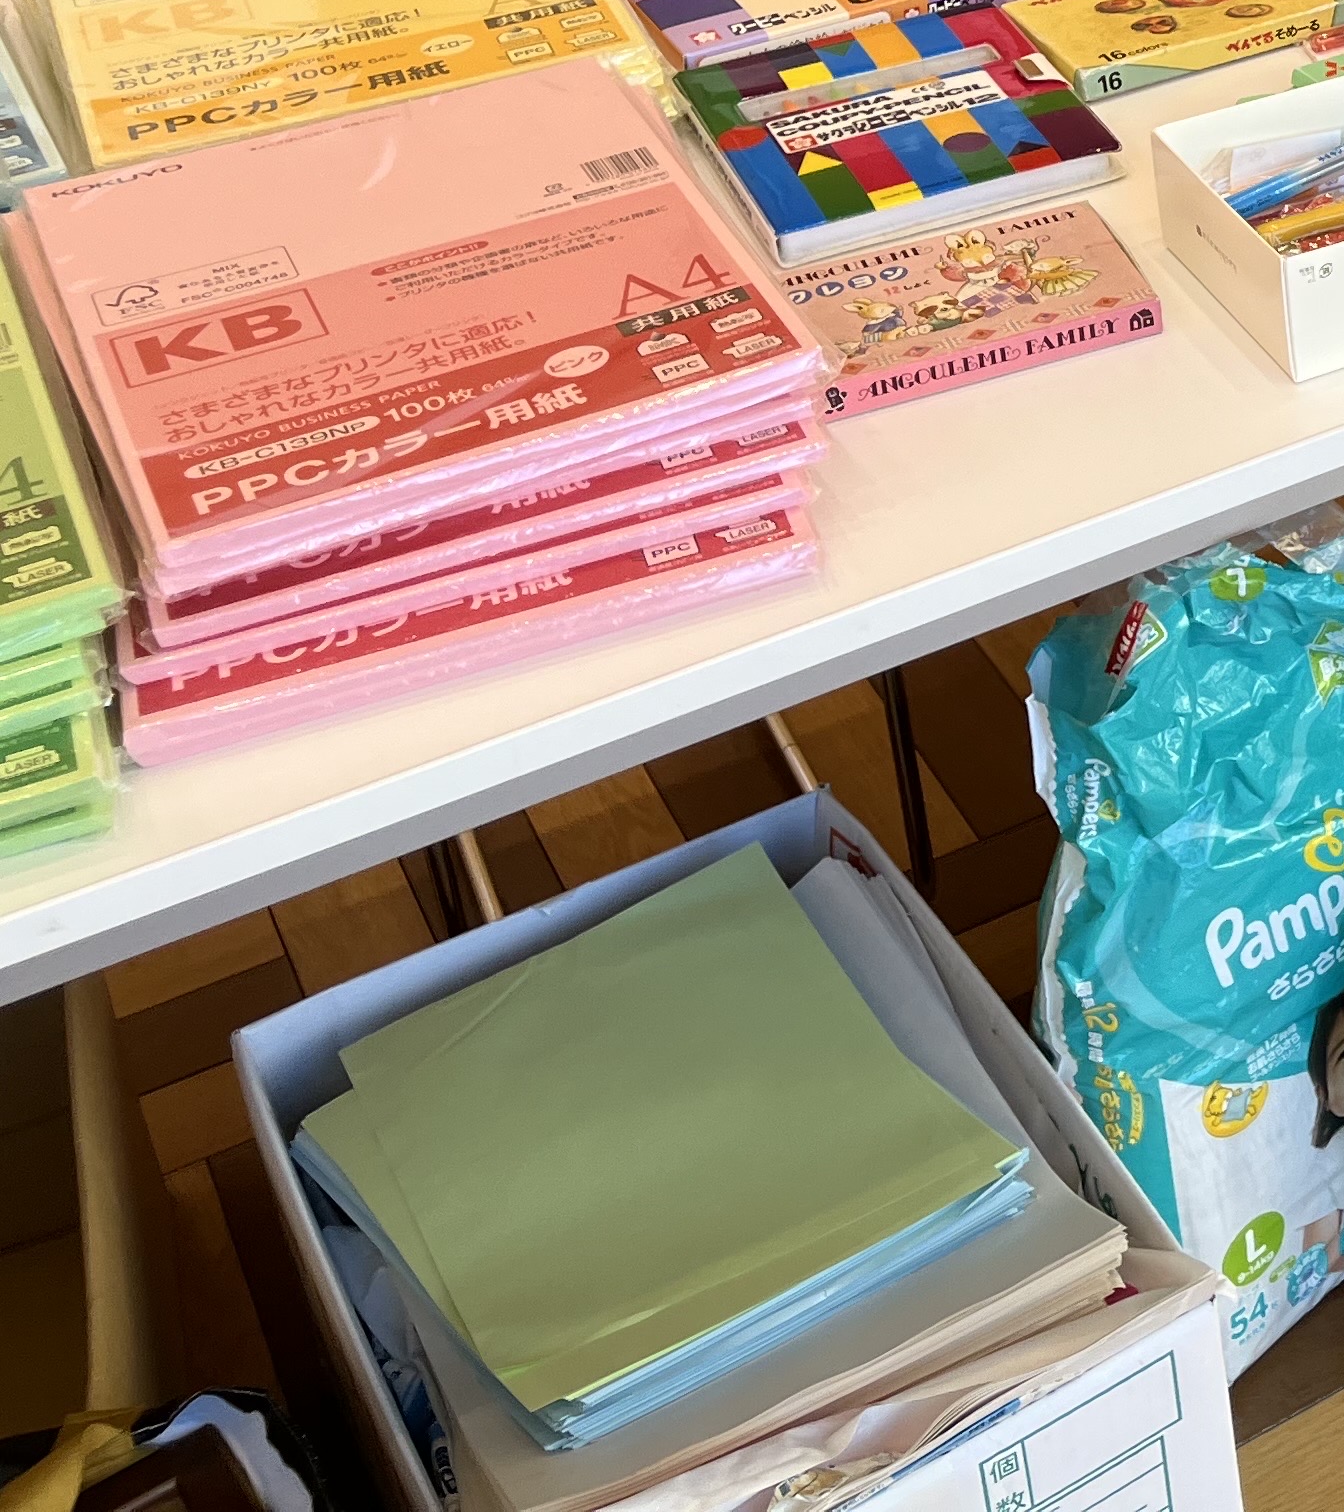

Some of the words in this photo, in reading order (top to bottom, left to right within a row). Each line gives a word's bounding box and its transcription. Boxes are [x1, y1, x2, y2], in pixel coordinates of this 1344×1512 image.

[1098, 48, 1128, 64] 16
[1127, 41, 1169, 58] colors
[121, 83, 196, 104] KOKUYO
[203, 66, 278, 88] BUSINESS
[284, 54, 336, 70] PAPER
[288, 60, 363, 83] 100枚
[1097, 71, 1123, 94] 16
[127, 59, 451, 141] PPCカラー用紙
[769, 93, 896, 130] SAKURA
[775, 82, 992, 139] COUPY-PENCIL
[51, 163, 184, 199] KOKUYO
[996, 208, 1079, 236] FAMILY
[612, 253, 736, 321] A4
[630, 290, 740, 334] 共用紙
[134, 304, 303, 376] KB
[735, 335, 778, 357] LASER
[548, 350, 607, 376] ピンク
[661, 358, 702, 378] PPC
[857, 345, 1022, 402] ANGOULEME
[1025, 316, 1123, 357] FAMILY
[178, 427, 272, 461] KOKUYO
[278, 400, 373, 432] BUSINESS
[379, 379, 441, 412] PAPER
[382, 387, 475, 424] 100枚
[190, 382, 589, 516] PPCカラー用紙
[726, 519, 772, 540] LASER
[650, 539, 692, 561] PPC
[15, 561, 68, 587] LASER
[1076, 758, 1113, 842] Pampers
[1243, 1229, 1267, 1264] L
